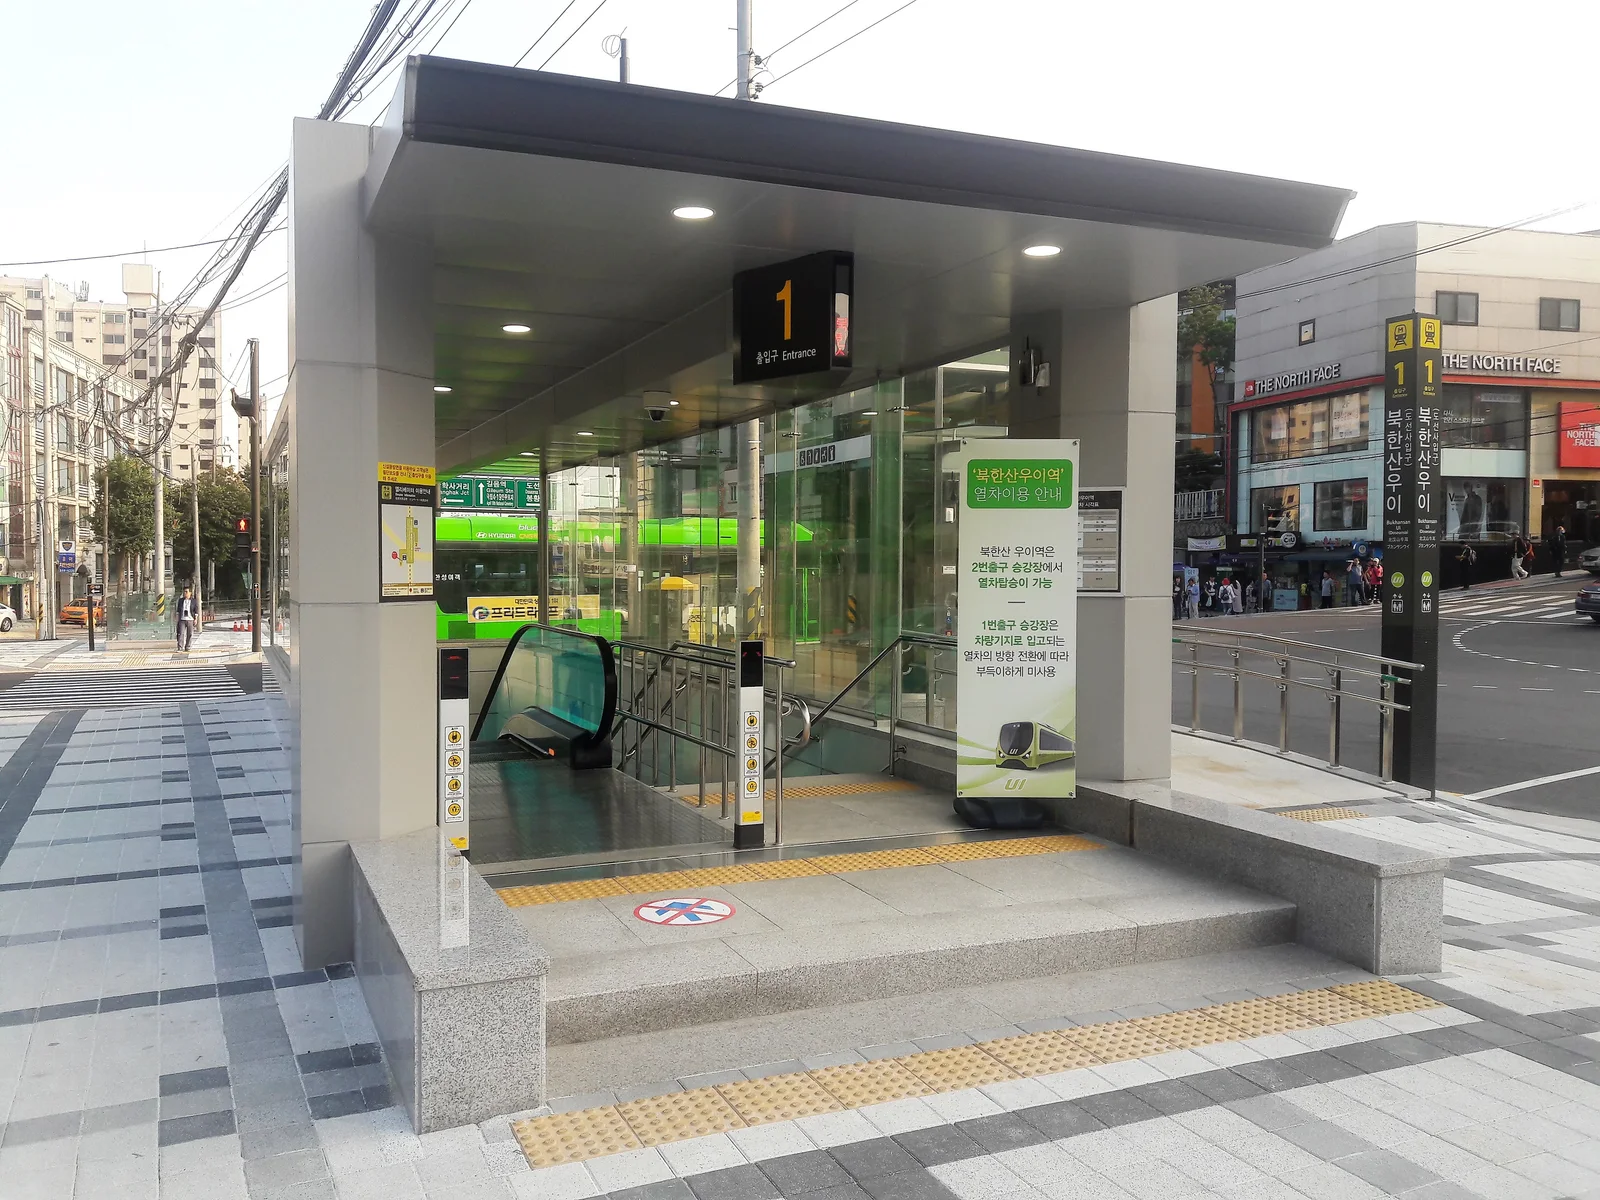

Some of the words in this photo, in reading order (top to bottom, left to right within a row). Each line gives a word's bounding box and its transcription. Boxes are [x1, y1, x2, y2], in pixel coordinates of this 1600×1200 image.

[776, 280, 791, 340] 1
[756, 350, 778, 365] 출입구
[783, 348, 816, 361] Entrance
[1442, 353, 1468, 369] THE
[1472, 355, 1523, 371] NORTH
[1526, 357, 1561, 373] FACE
[1255, 379, 1274, 393] THE
[1275, 370, 1311, 389] NORTH
[1312, 363, 1340, 382] FACE
[1394, 361, 1404, 385] 1
[1425, 360, 1433, 383] 1
[1404, 408, 1413, 466] (도선사입구)
[1432, 408, 1440, 466] (도선사입구)
[1567, 430, 1595, 438] NORTH
[1386, 409, 1403, 513] 북한산우이
[1418, 407, 1431, 512] 북한산우이
[974, 487, 1030, 502] 열차이용
[1034, 487, 1062, 502] 안내
[980, 546, 1011, 557] 북한산
[1014, 546, 1055, 557] 우이역은
[972, 562, 1008, 573] 2번출구
[1012, 562, 1063, 573] 승강장에서
[978, 577, 1028, 588] 열차탑승이
[1032, 577, 1053, 588] 가능
[982, 620, 1016, 631] 1번출구
[1020, 620, 1059, 631] 승강장은
[975, 635, 1023, 647] 차량기지로
[1027, 635, 1065, 647] 입고되는
[964, 650, 992, 661] 열차의
[995, 650, 1014, 662] 방향
[1018, 650, 1047, 662] 전환에
[1050, 650, 1069, 661] 따라
[976, 666, 1024, 677] 부득이하게
[1027, 665, 1056, 677] 미사용
